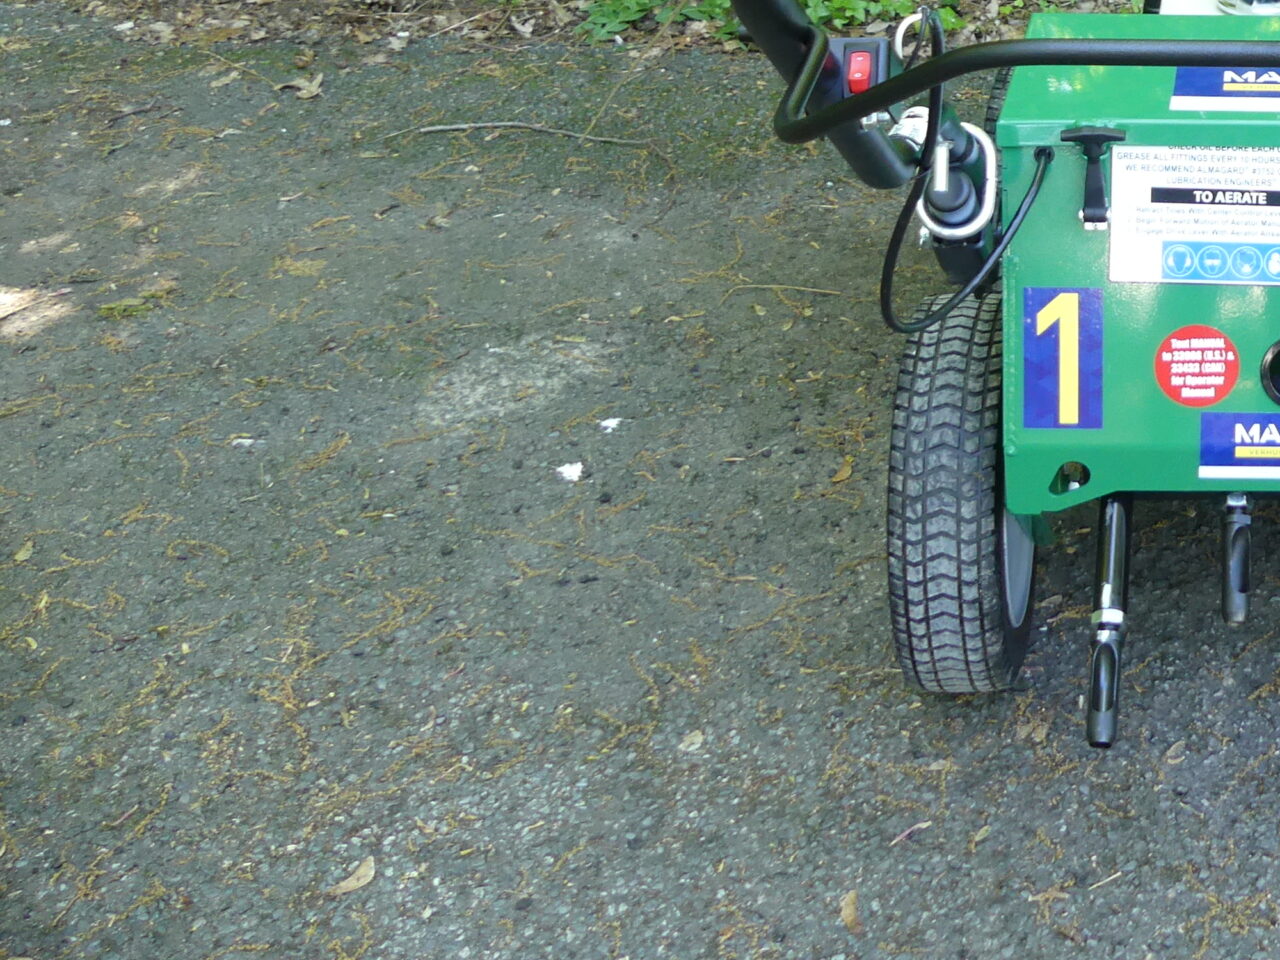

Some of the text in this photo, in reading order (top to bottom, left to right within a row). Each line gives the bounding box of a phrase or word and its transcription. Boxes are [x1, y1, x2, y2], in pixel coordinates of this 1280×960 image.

[1116, 151, 1150, 160] GREASE
[1170, 153, 1208, 162] FITTINGS
[1211, 154, 1237, 163] EVERY
[1252, 155, 1280, 164] HOURS
[1140, 164, 1195, 172] RECOMMEND
[1166, 176, 1222, 185] LUBRICATION
[1193, 191, 1267, 204] TO AERATE
[1036, 292, 1079, 425] 1
